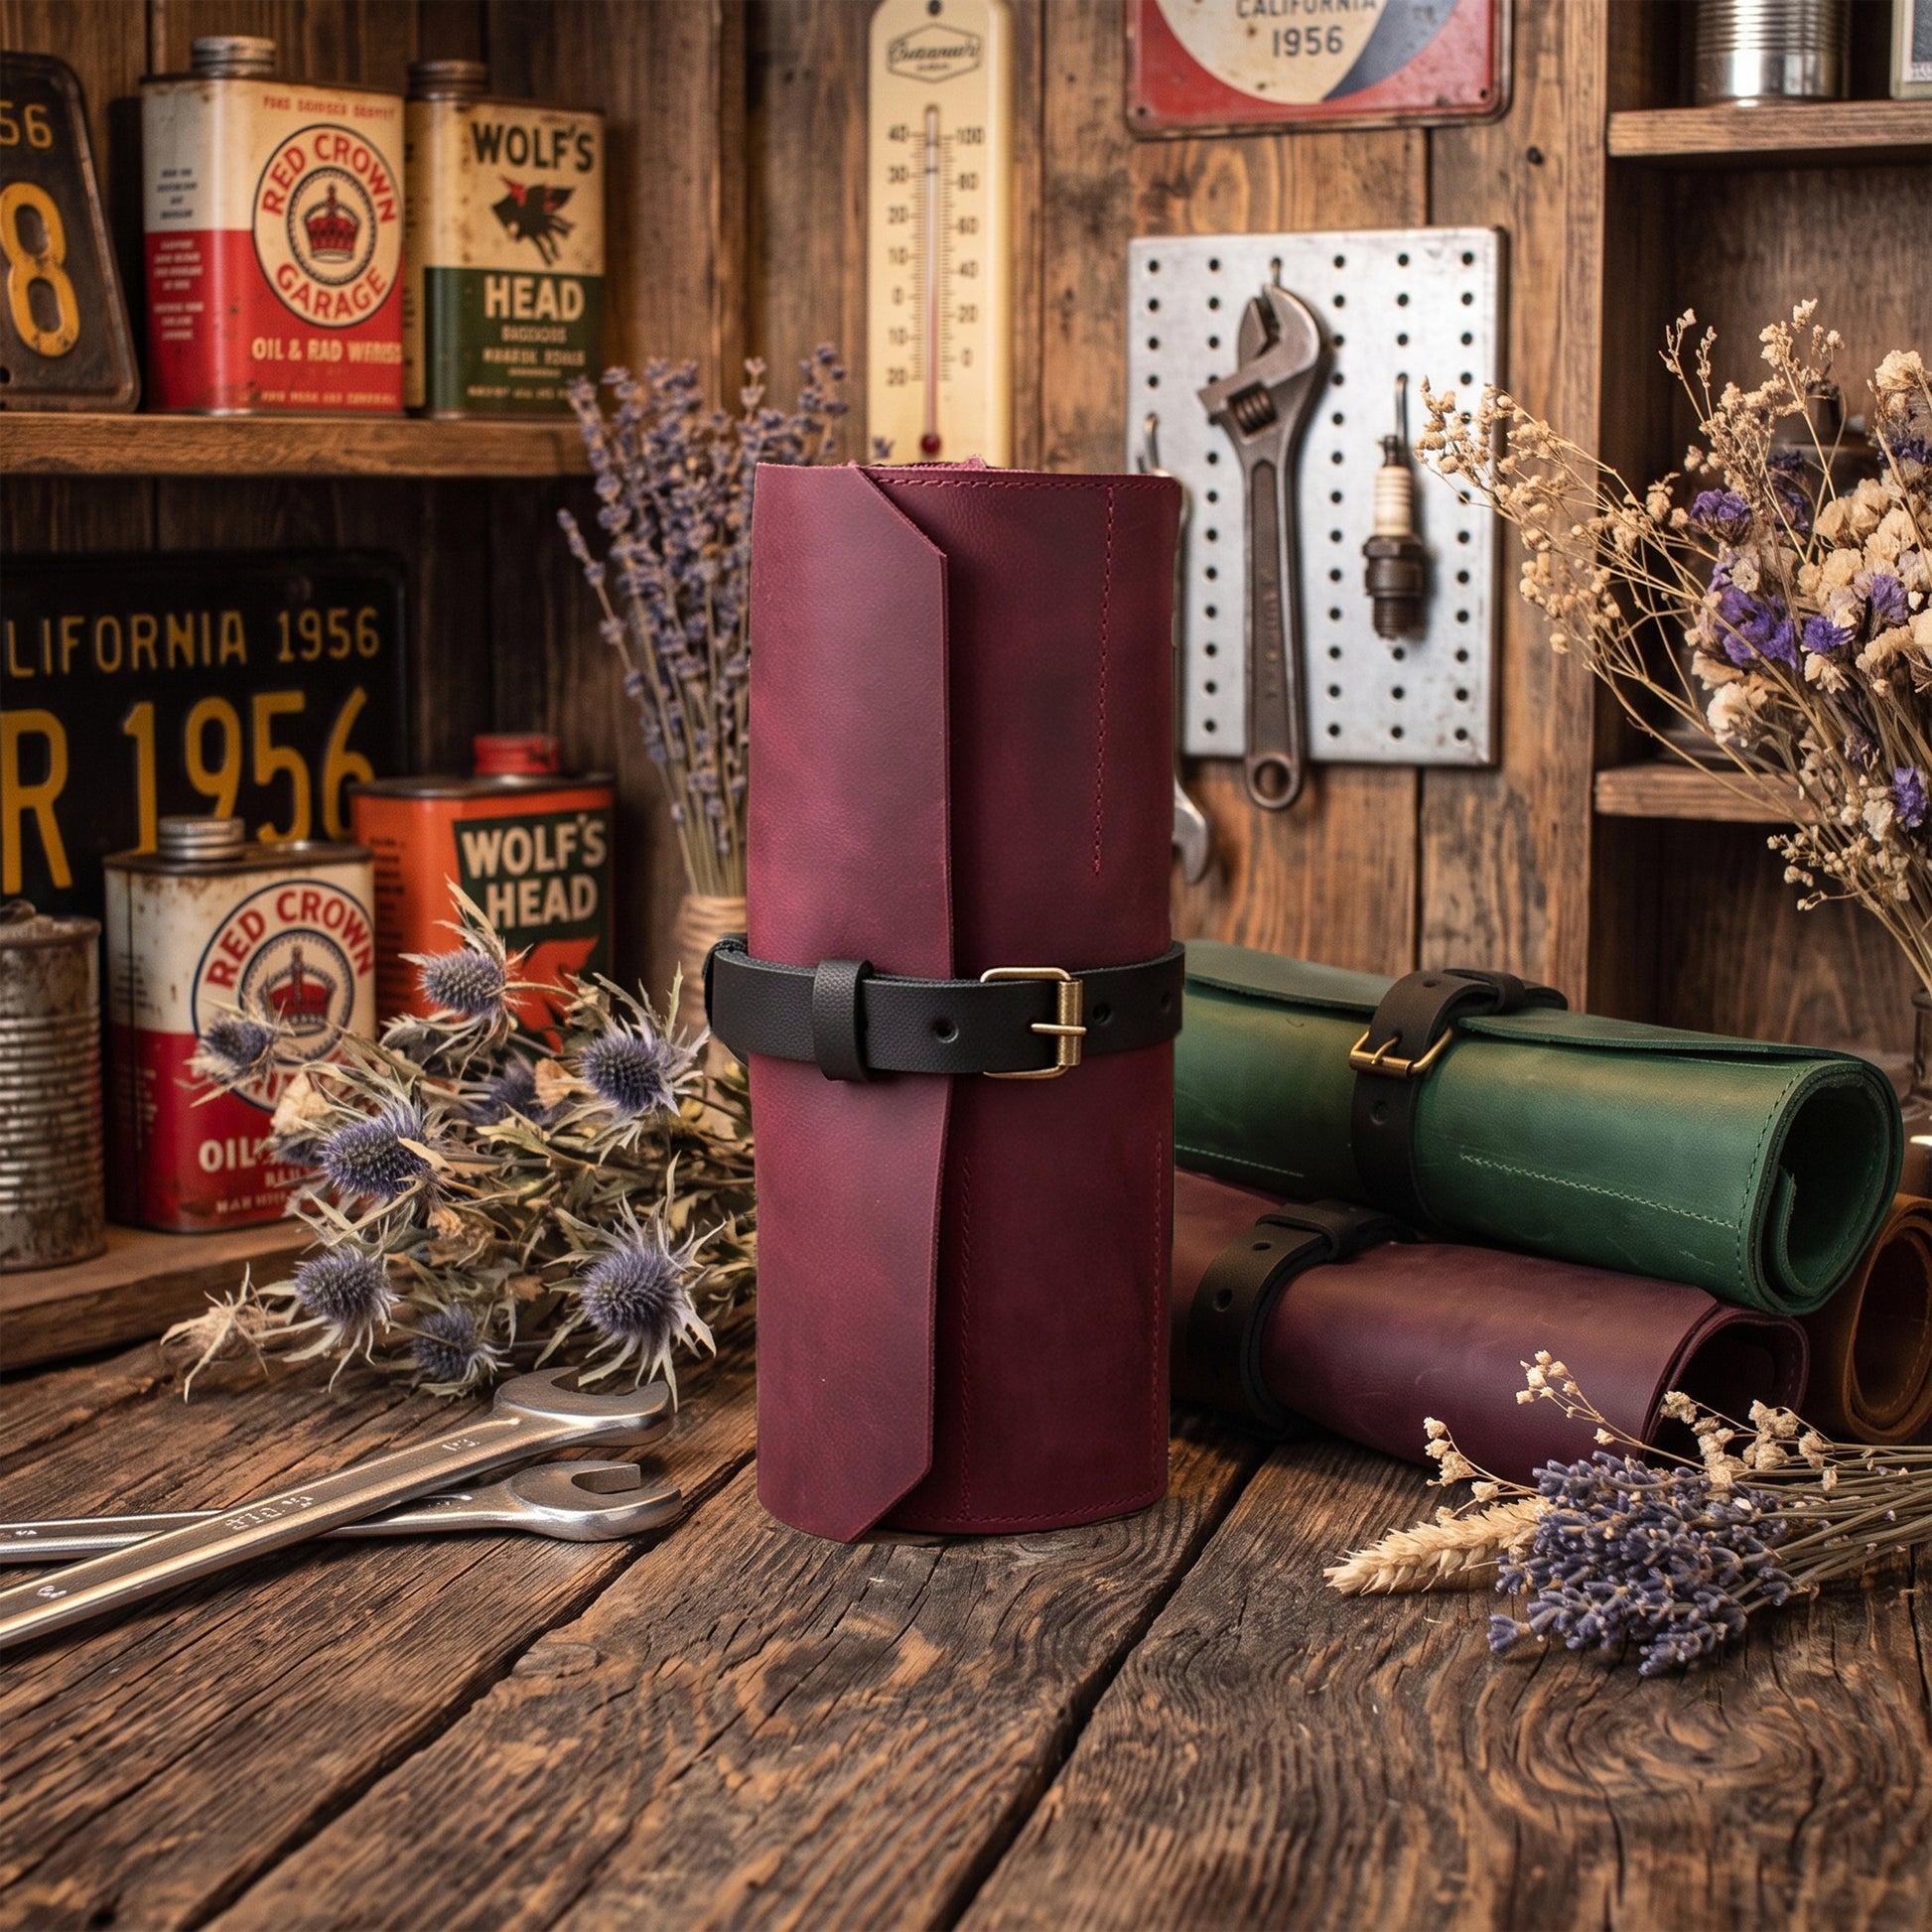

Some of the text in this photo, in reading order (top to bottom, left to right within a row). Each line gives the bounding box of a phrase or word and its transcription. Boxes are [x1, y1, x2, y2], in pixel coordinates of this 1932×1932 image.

[1273, 26, 1344, 57] 1956
[889, 125, 907, 142] 40
[956, 127, 984, 145] 100
[472, 121, 594, 173] WOLF'S
[261, 146, 306, 216] RED
[314, 134, 397, 223] CROWN
[889, 166, 907, 184] 30
[958, 173, 978, 191] 80
[889, 206, 907, 224] 20
[890, 246, 907, 265] 10
[0, 181, 80, 357] 8
[959, 260, 979, 279] 40
[276, 263, 386, 320] GARAGE
[483, 275, 586, 322] HEAD
[891, 286, 904, 306] 0
[958, 304, 978, 324] 20
[888, 326, 907, 345] 10
[251, 337, 285, 361] OIL
[288, 338, 302, 361] &
[960, 347, 973, 368] 0
[887, 367, 907, 387] 20
[7, 606, 380, 677] LIFORNIA 1956
[461, 813, 607, 879] WOLF'S
[485, 874, 598, 929] HEAD
[206, 908, 266, 989] RED
[277, 890, 373, 977] CROWN
